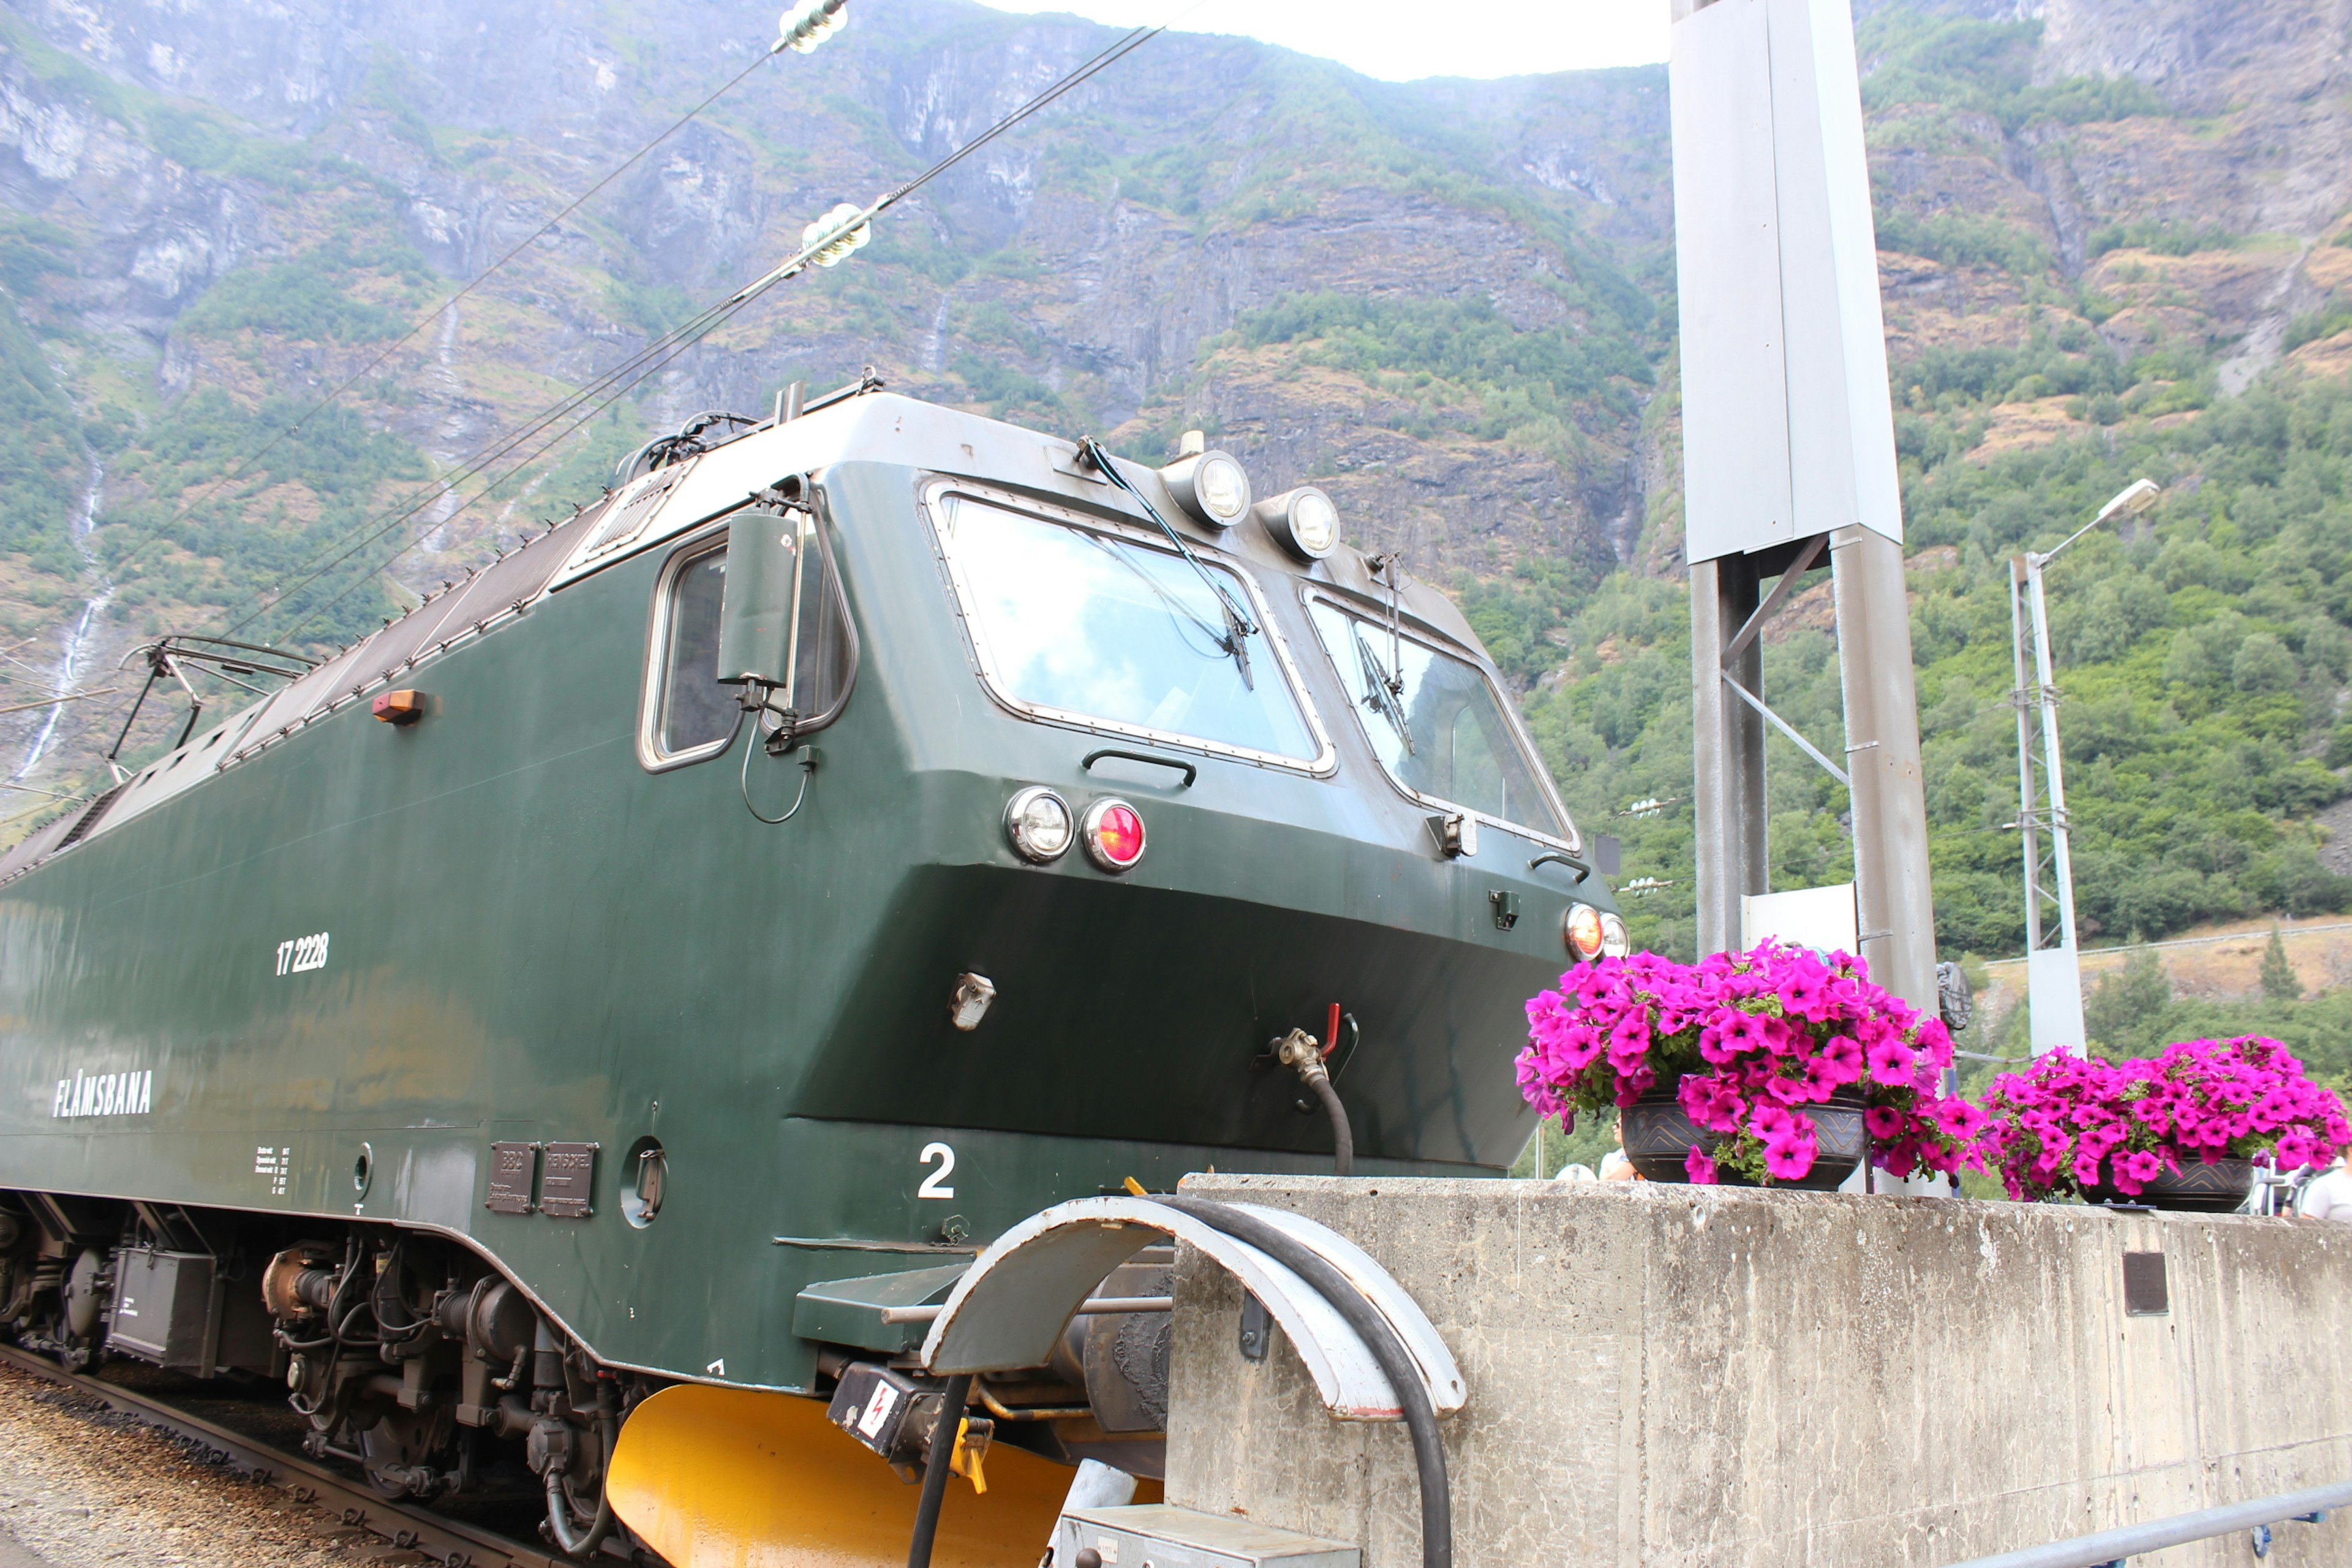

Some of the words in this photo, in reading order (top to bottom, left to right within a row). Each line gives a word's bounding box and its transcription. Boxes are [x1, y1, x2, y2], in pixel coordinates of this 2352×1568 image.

[276, 940, 295, 976] 17
[292, 931, 330, 973] 2228
[52, 1068, 153, 1118] FLÅMSBANA
[501, 1151, 523, 1170] BBC
[547, 1153, 590, 1169] HENSCHEL
[917, 1142, 956, 1199] 2
